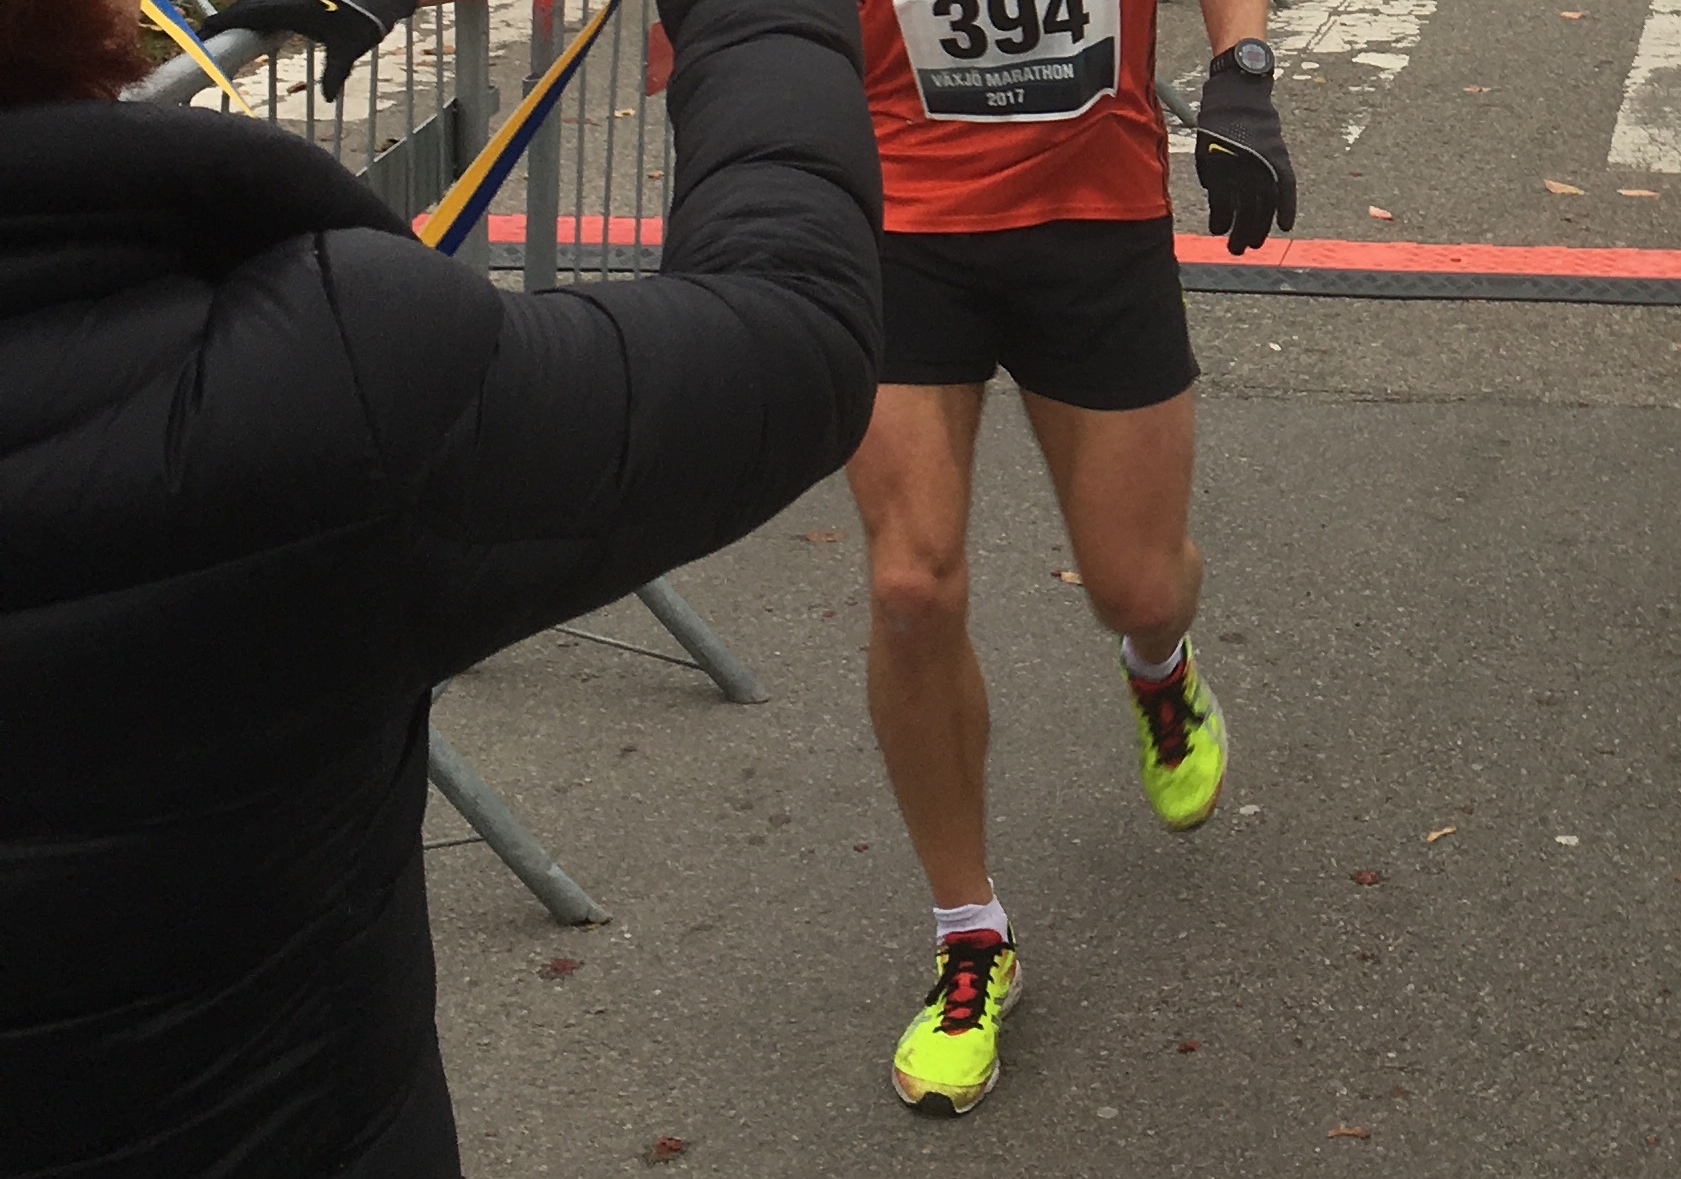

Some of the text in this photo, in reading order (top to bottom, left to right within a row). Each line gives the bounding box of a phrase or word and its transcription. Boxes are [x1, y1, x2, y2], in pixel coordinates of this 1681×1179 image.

[930, 63, 1074, 87] VÄXJÖ MARATHON
[985, 88, 1025, 107] 2017
